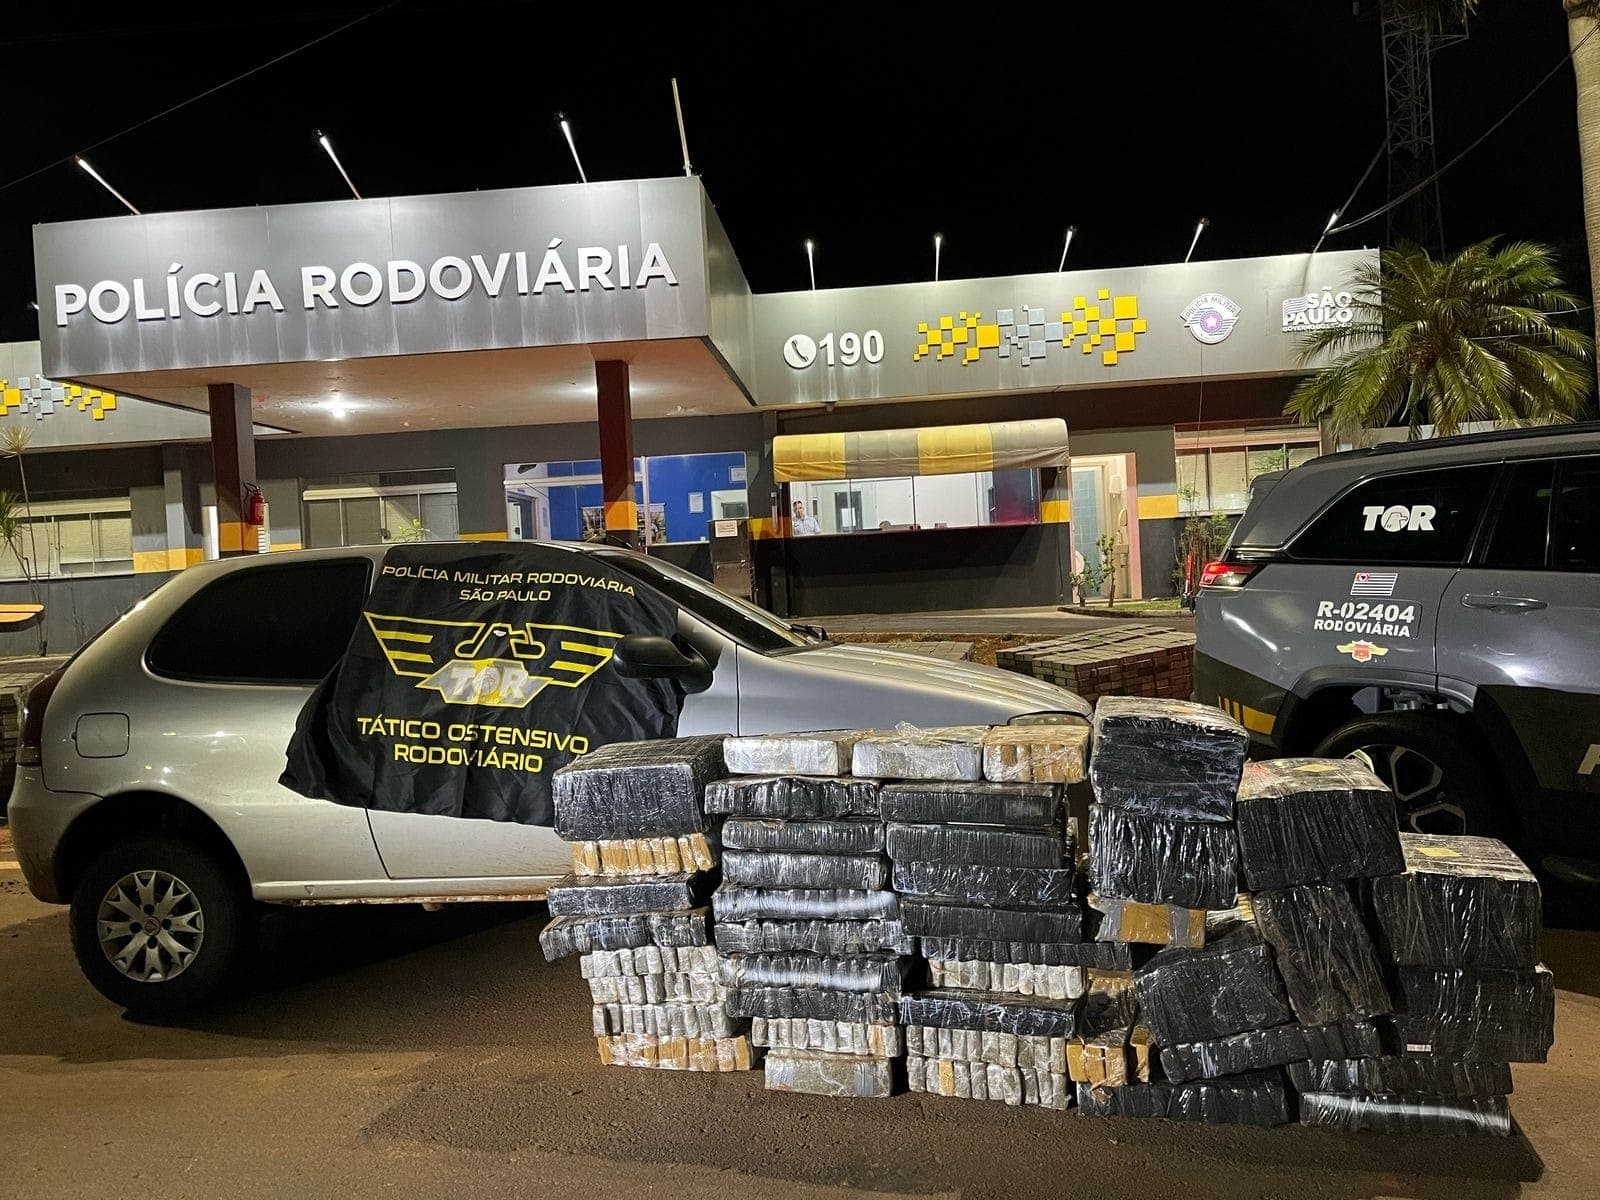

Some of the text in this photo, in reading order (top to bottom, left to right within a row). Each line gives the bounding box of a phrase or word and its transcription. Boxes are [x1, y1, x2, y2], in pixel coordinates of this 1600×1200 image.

[54, 236, 680, 327] POLÍCIA RODOVIÁRIA
[1306, 286, 1353, 309] SÃO
[1282, 307, 1354, 327] PAULO
[819, 329, 885, 367] 190
[1362, 504, 1437, 533] TOR
[382, 565, 635, 597] POLÍCIA MILITAR RODOVIÁRIA
[458, 588, 551, 602] SÃO PAULO
[1317, 600, 1416, 624] R-02404
[1313, 618, 1411, 638] RODOVIÁRIA
[357, 714, 589, 755] TÁTICO OSTENSIVO
[394, 743, 543, 773] RODOVIÁRIO
